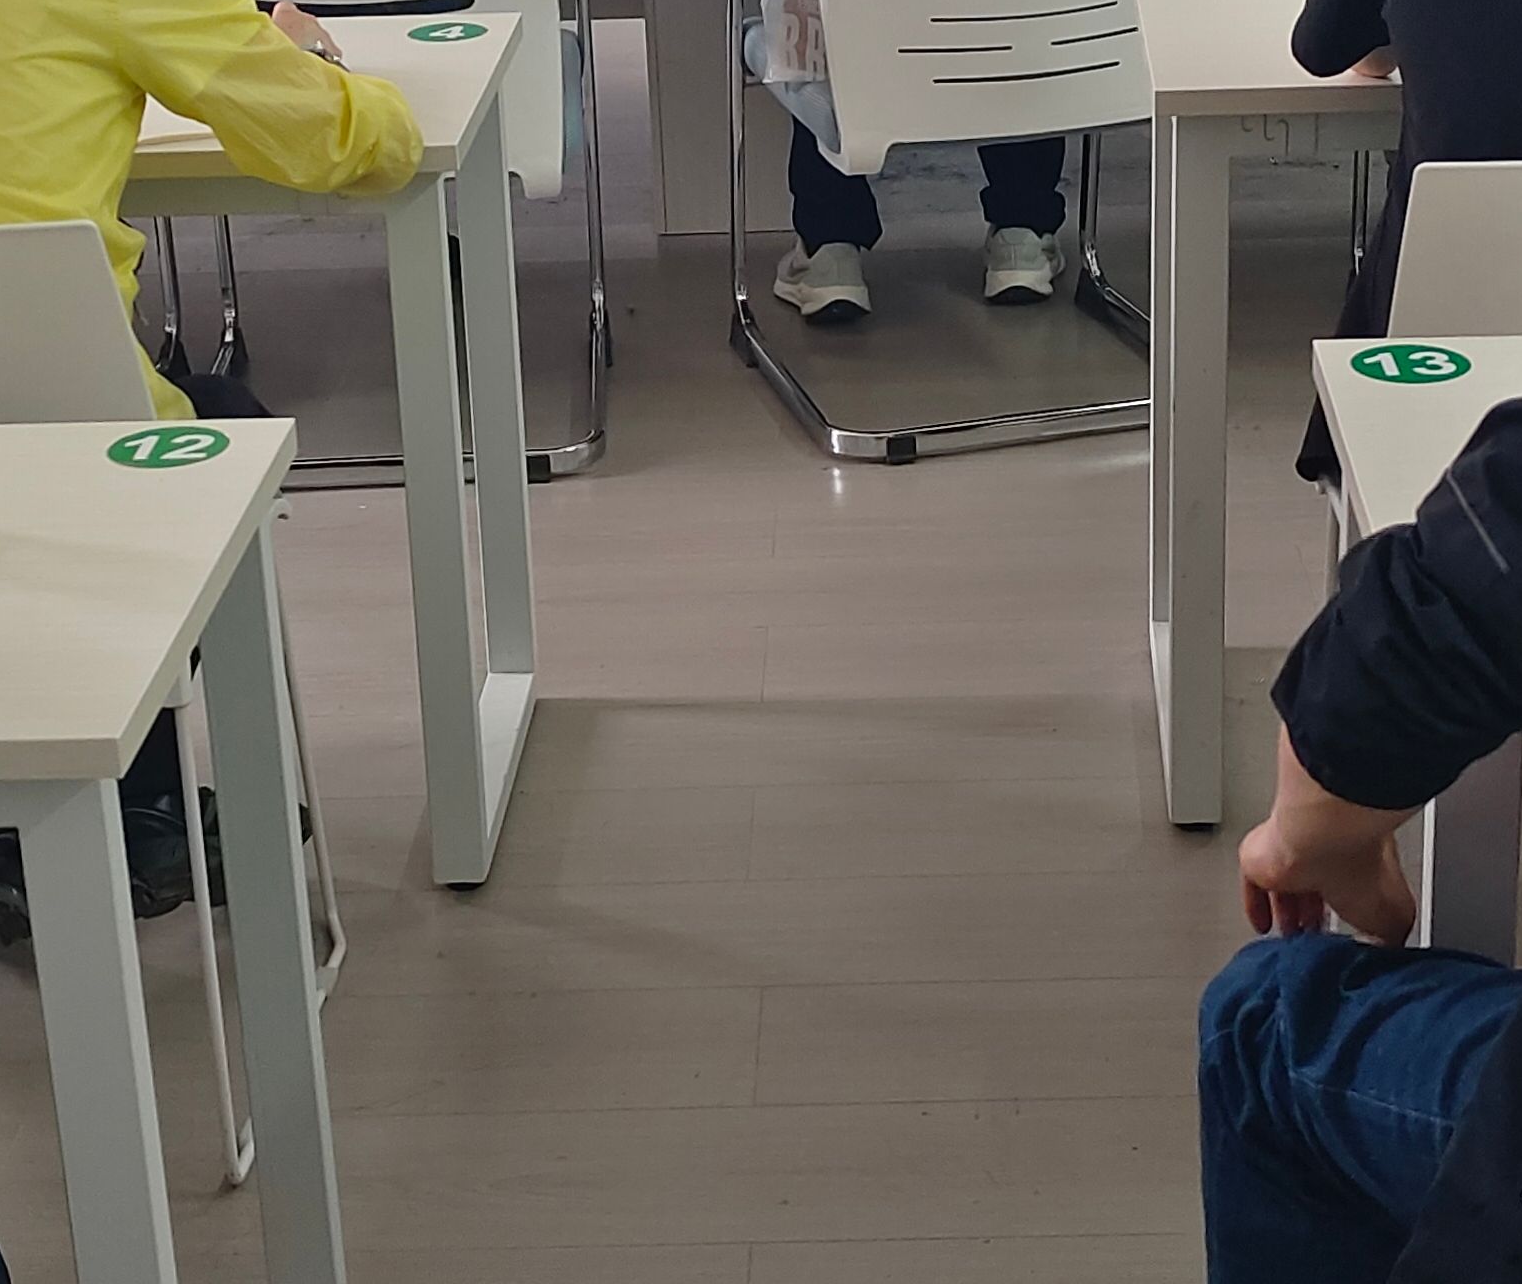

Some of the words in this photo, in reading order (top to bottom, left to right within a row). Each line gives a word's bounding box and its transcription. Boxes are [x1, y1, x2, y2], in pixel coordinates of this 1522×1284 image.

[428, 25, 465, 39] 4
[1363, 351, 1458, 377] 13
[124, 434, 216, 461] 12
